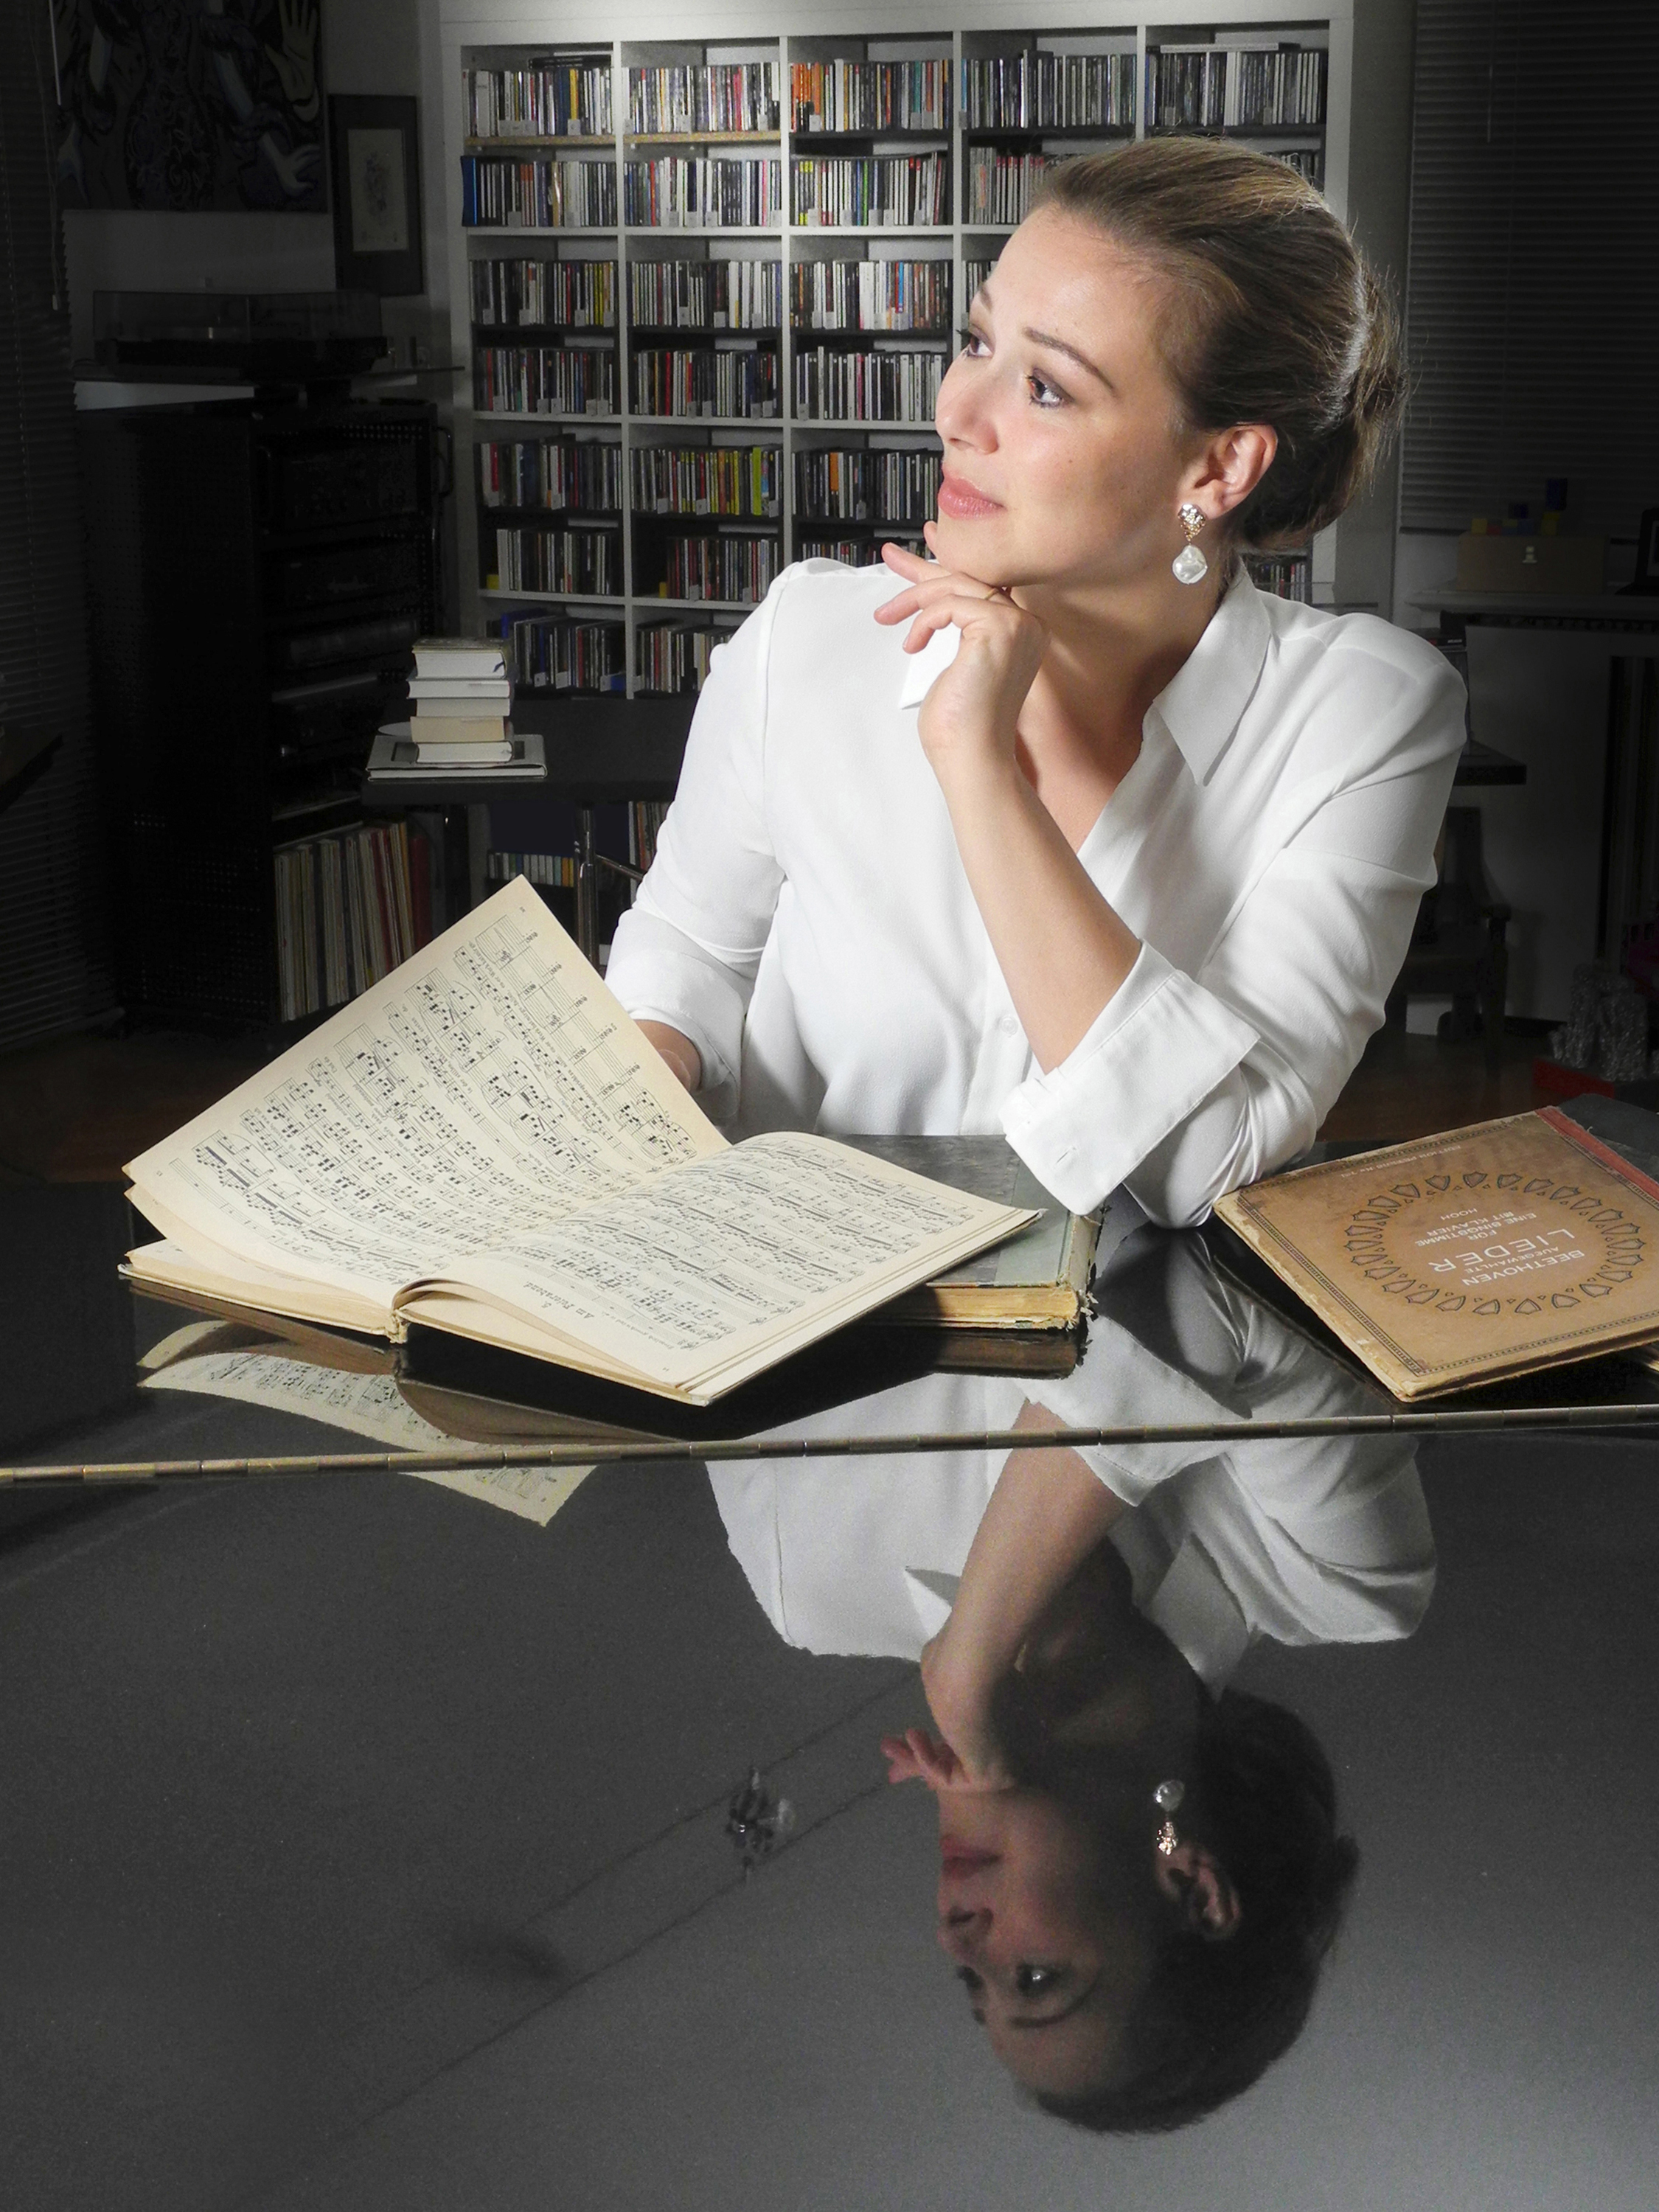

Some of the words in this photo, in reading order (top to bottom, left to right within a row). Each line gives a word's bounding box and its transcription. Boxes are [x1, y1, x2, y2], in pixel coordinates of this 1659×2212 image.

[1440, 1208, 1478, 1220] HOCH
[1492, 1210, 1514, 1220] MIT
[1504, 1212, 1537, 1225] EINE
[1415, 1220, 1503, 1247] SINGSTIMME
[1427, 1217, 1489, 1237] KLAVIER
[1427, 1228, 1575, 1273] LIEDER
[1461, 1249, 1585, 1286] BEETHOVEN
